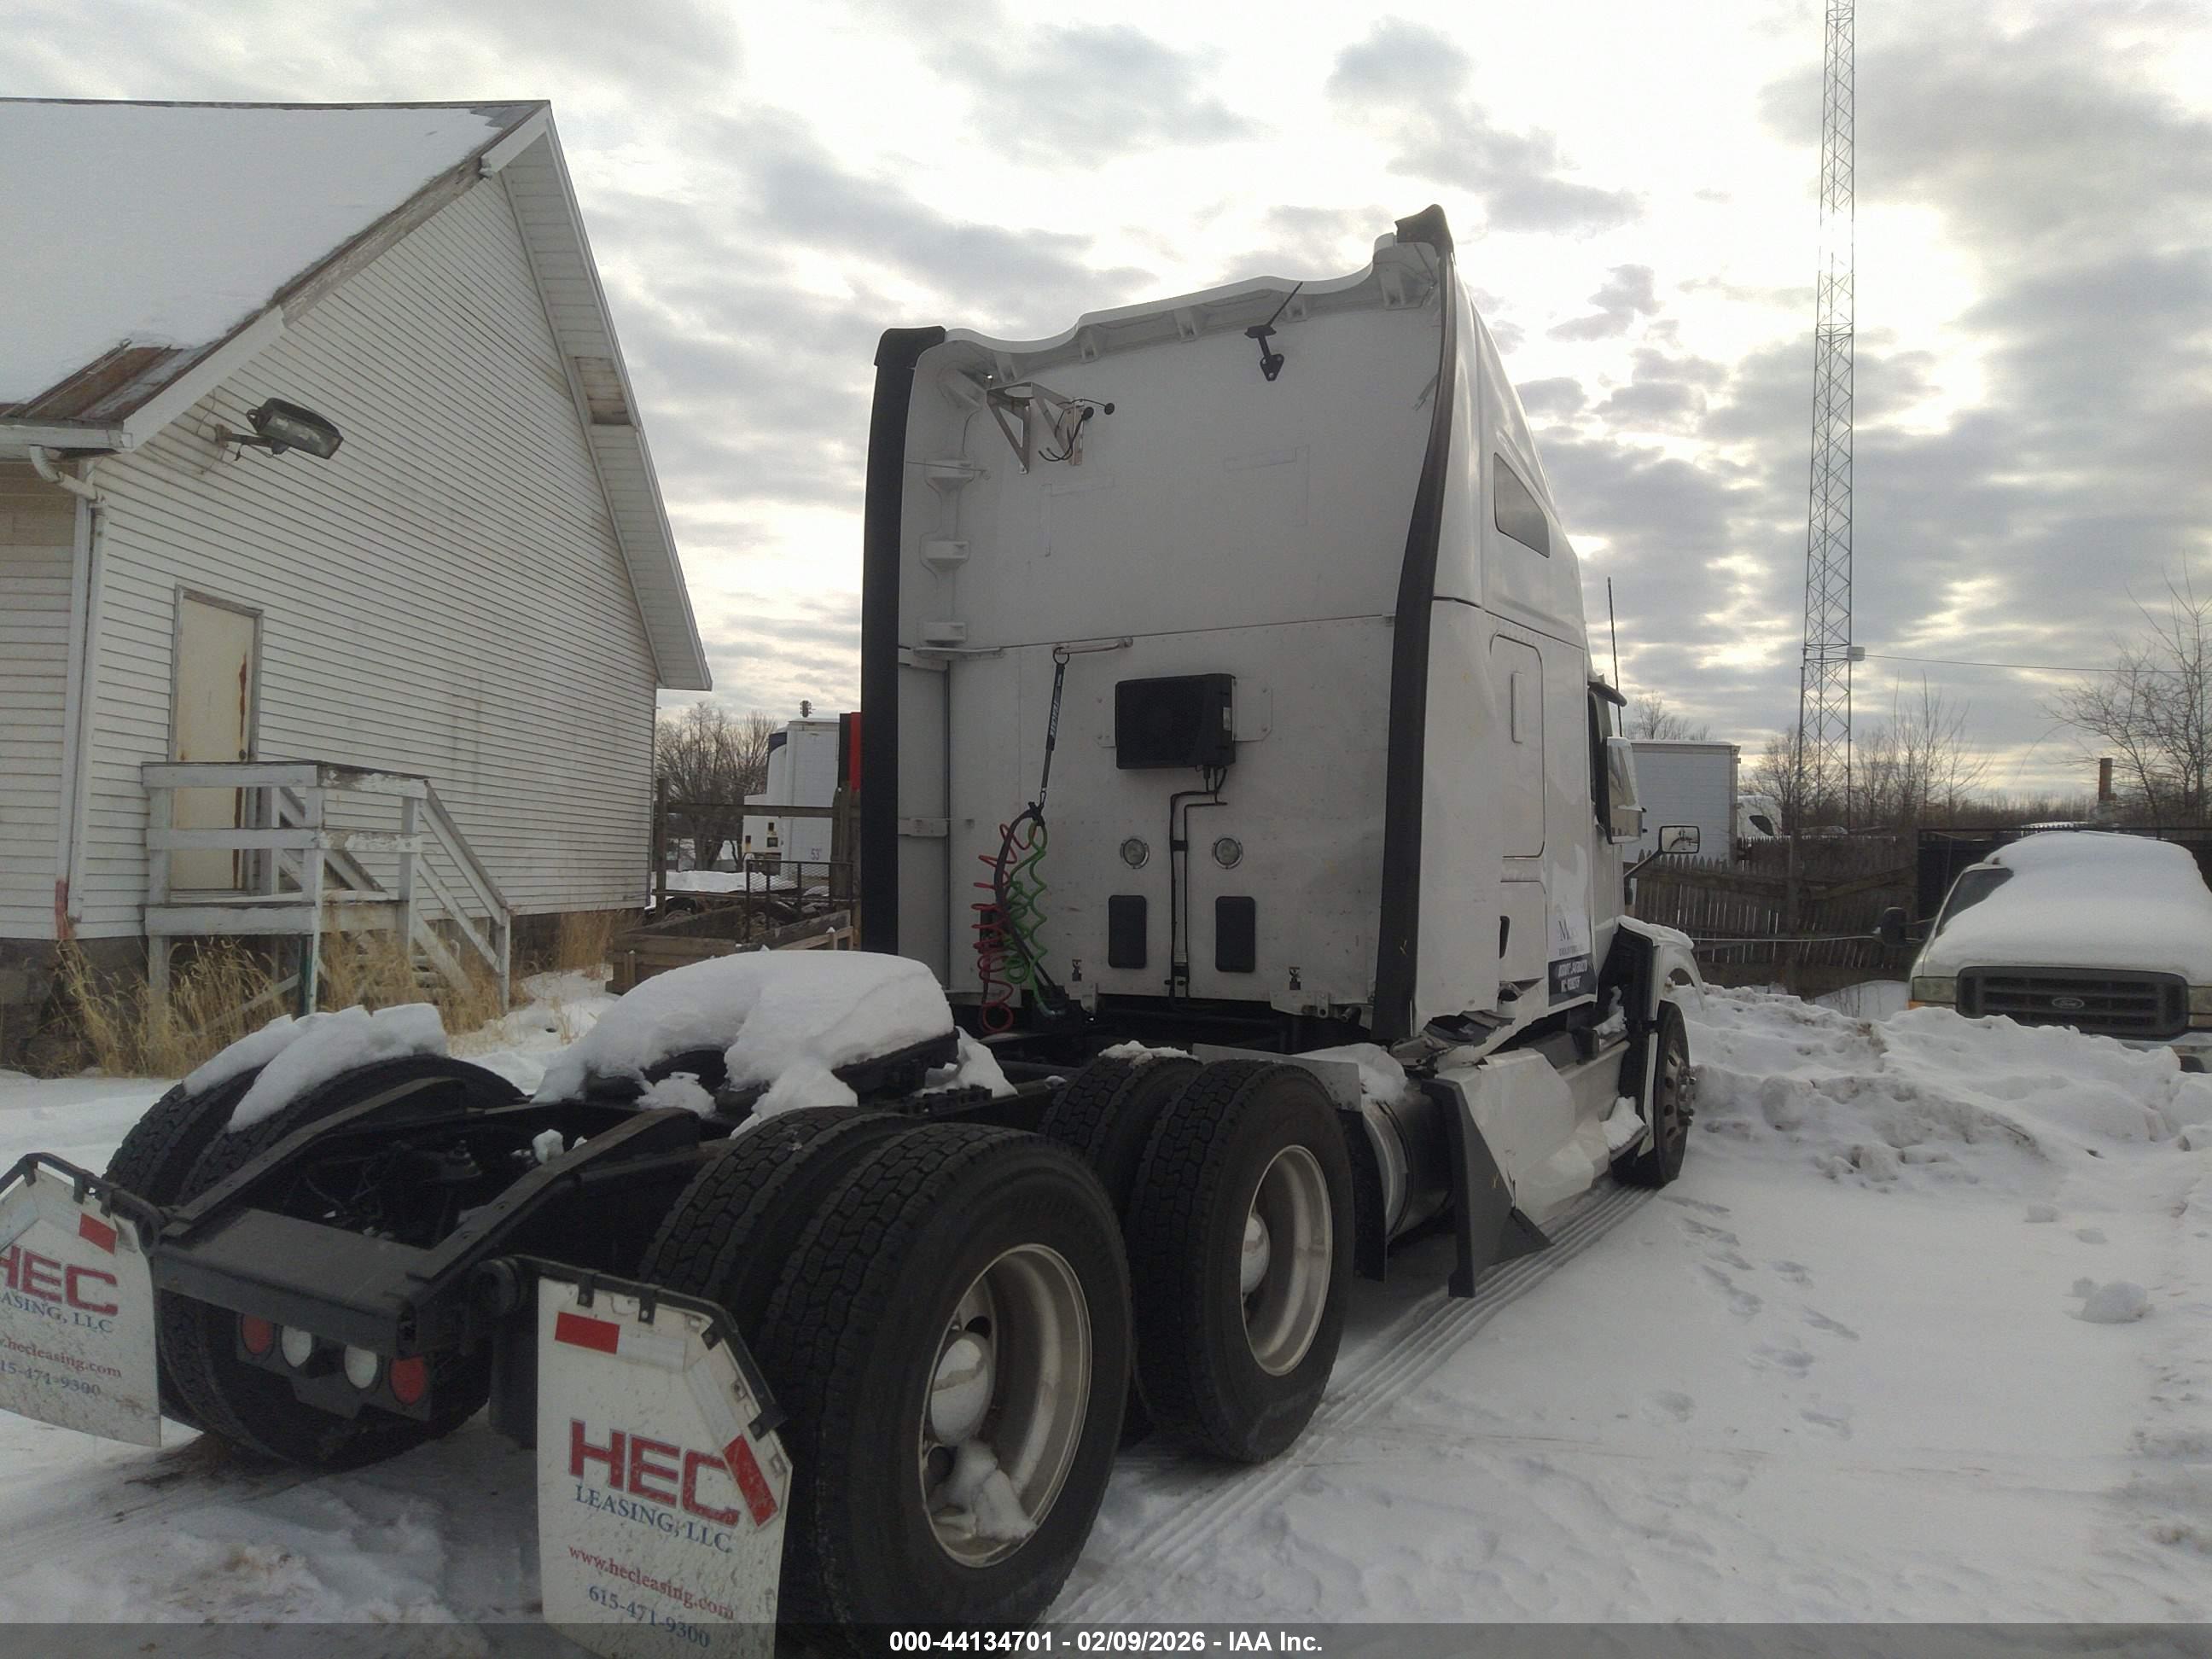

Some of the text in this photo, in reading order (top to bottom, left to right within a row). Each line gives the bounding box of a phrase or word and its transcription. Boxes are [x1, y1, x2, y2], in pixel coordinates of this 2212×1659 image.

[0, 1291, 114, 1334] ASING, LLC
[0, 1334, 122, 1377] .hecleasing.com
[0, 1359, 102, 1396] 15-471-9300
[570, 1419, 740, 1526] HEC
[574, 1484, 732, 1553] LEASING, LLC
[568, 1545, 735, 1620] www.hecleasing.com
[589, 1586, 711, 1648] 615-471-9300
